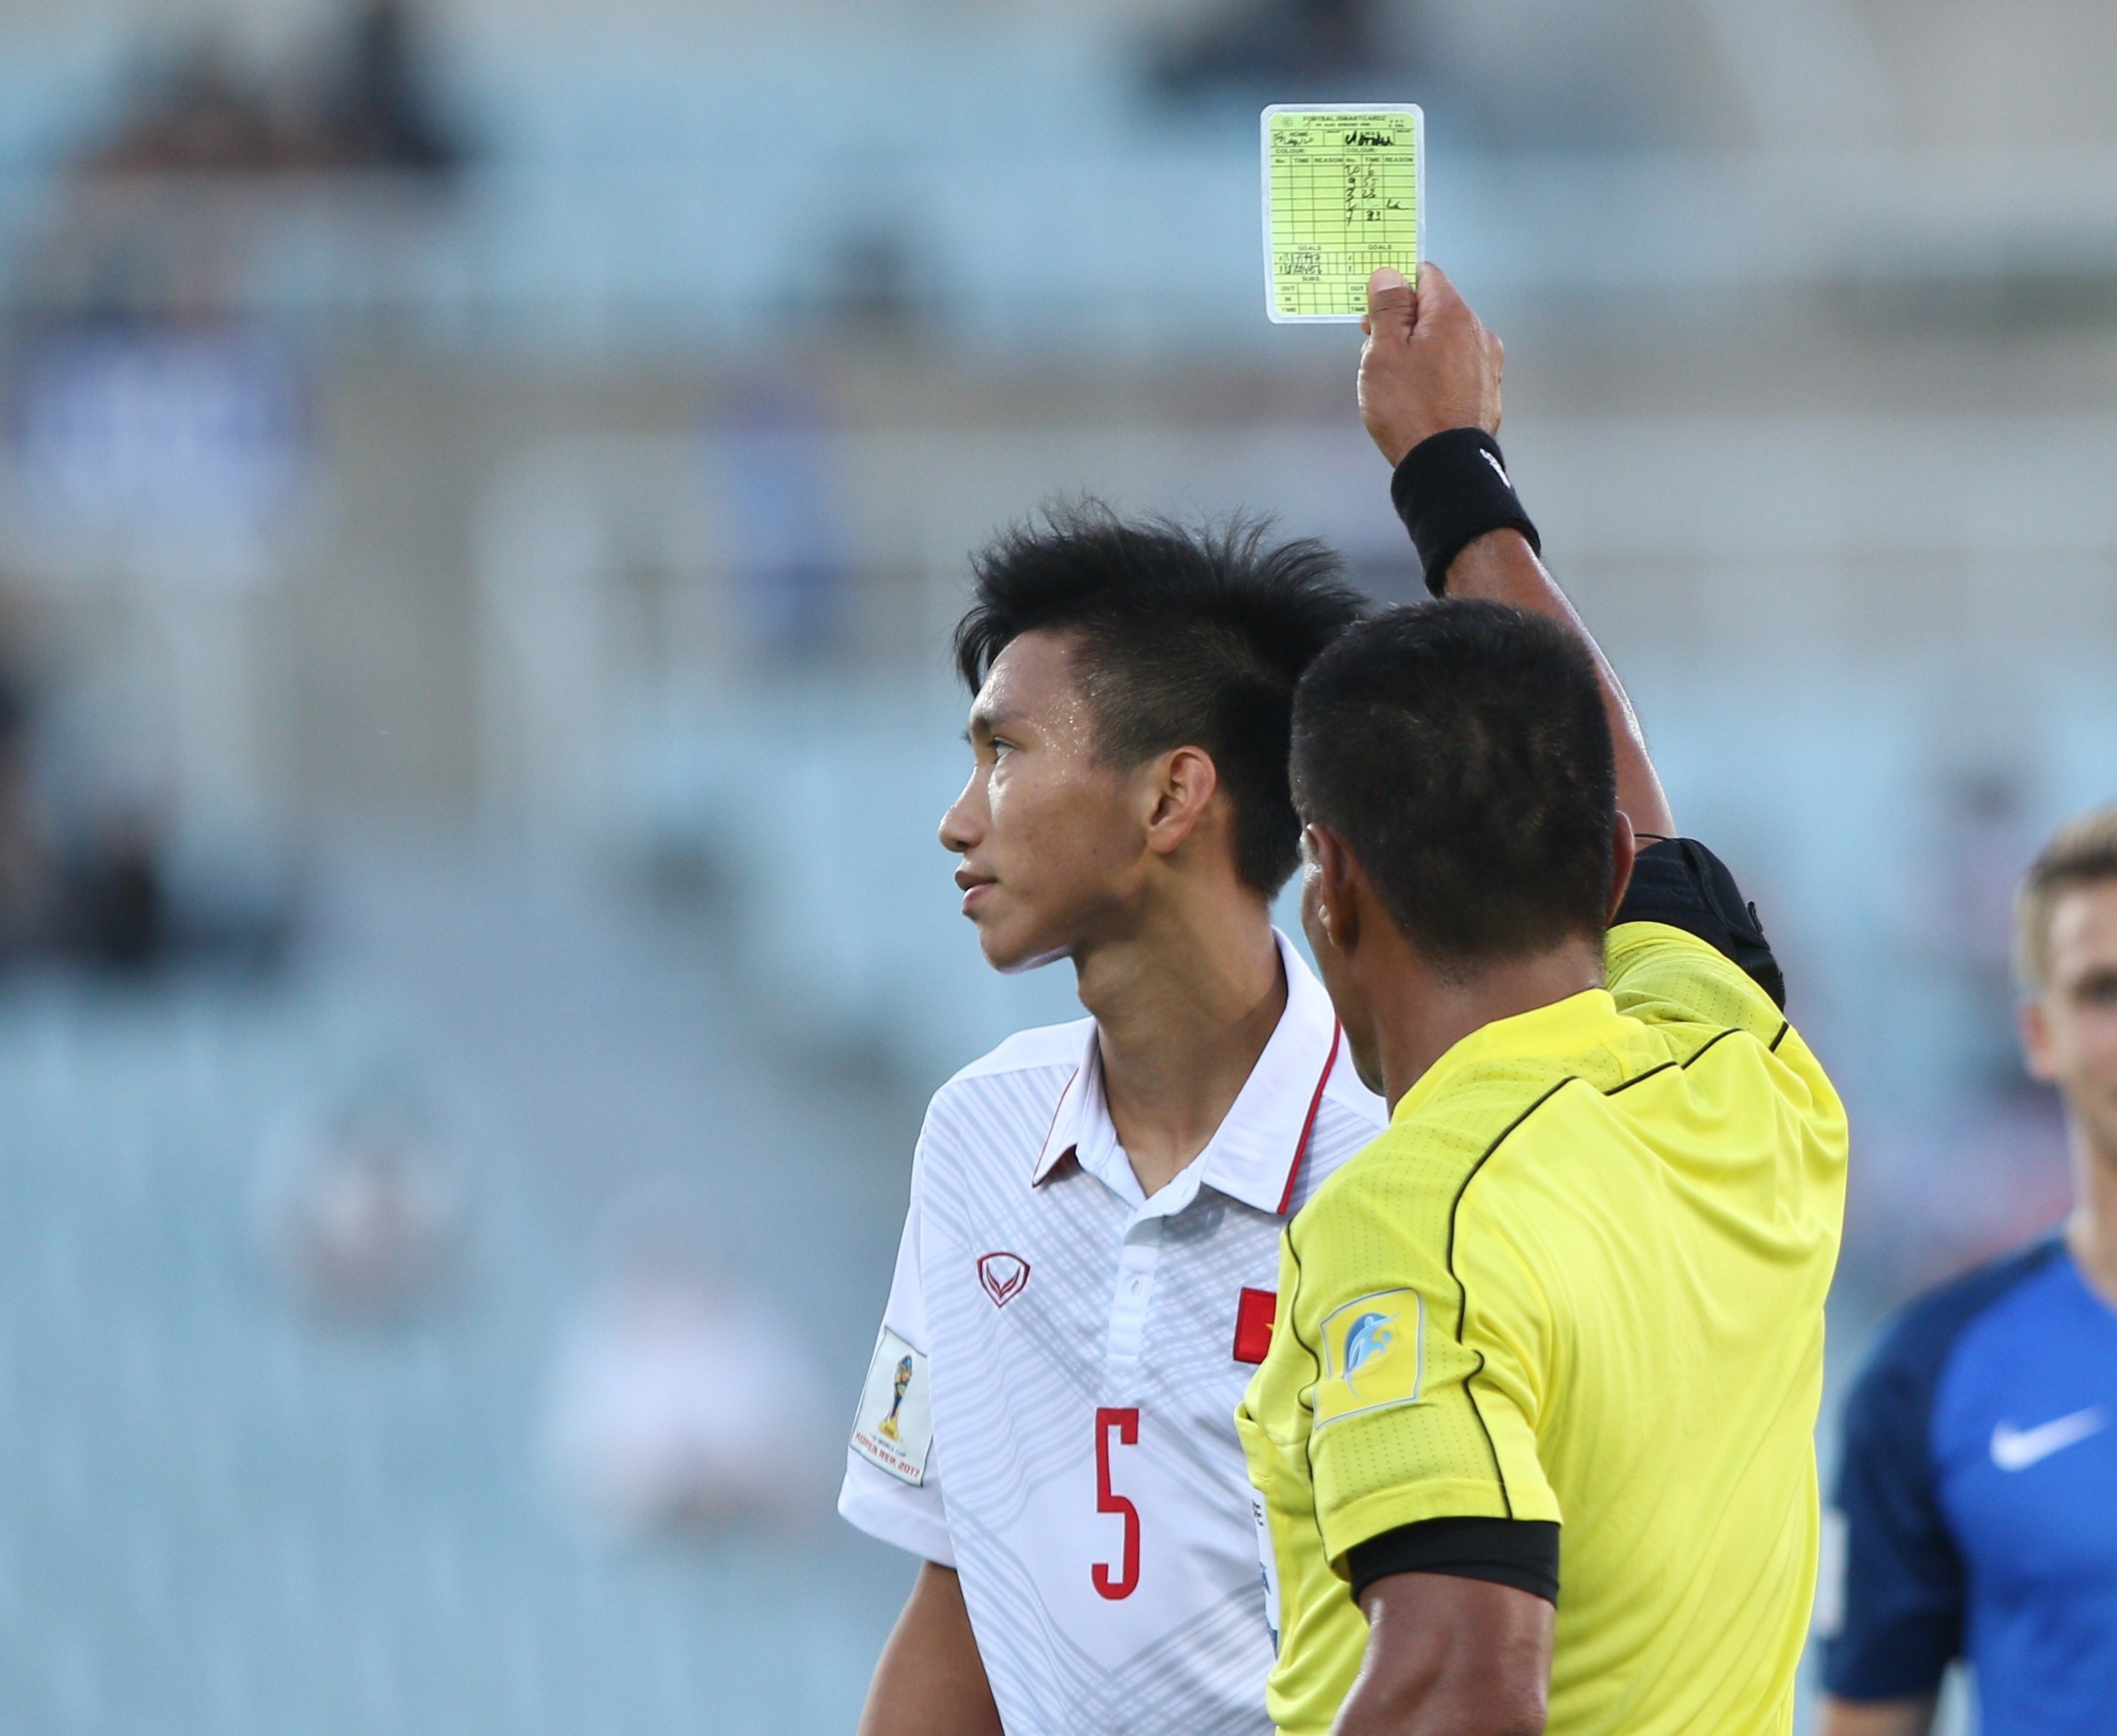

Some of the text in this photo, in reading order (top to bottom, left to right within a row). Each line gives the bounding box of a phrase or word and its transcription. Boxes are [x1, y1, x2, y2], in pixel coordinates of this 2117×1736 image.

[855, 1431, 877, 1456] KOREA
[898, 1461, 921, 1478] 2017
[1091, 1407, 1140, 1601] 5
